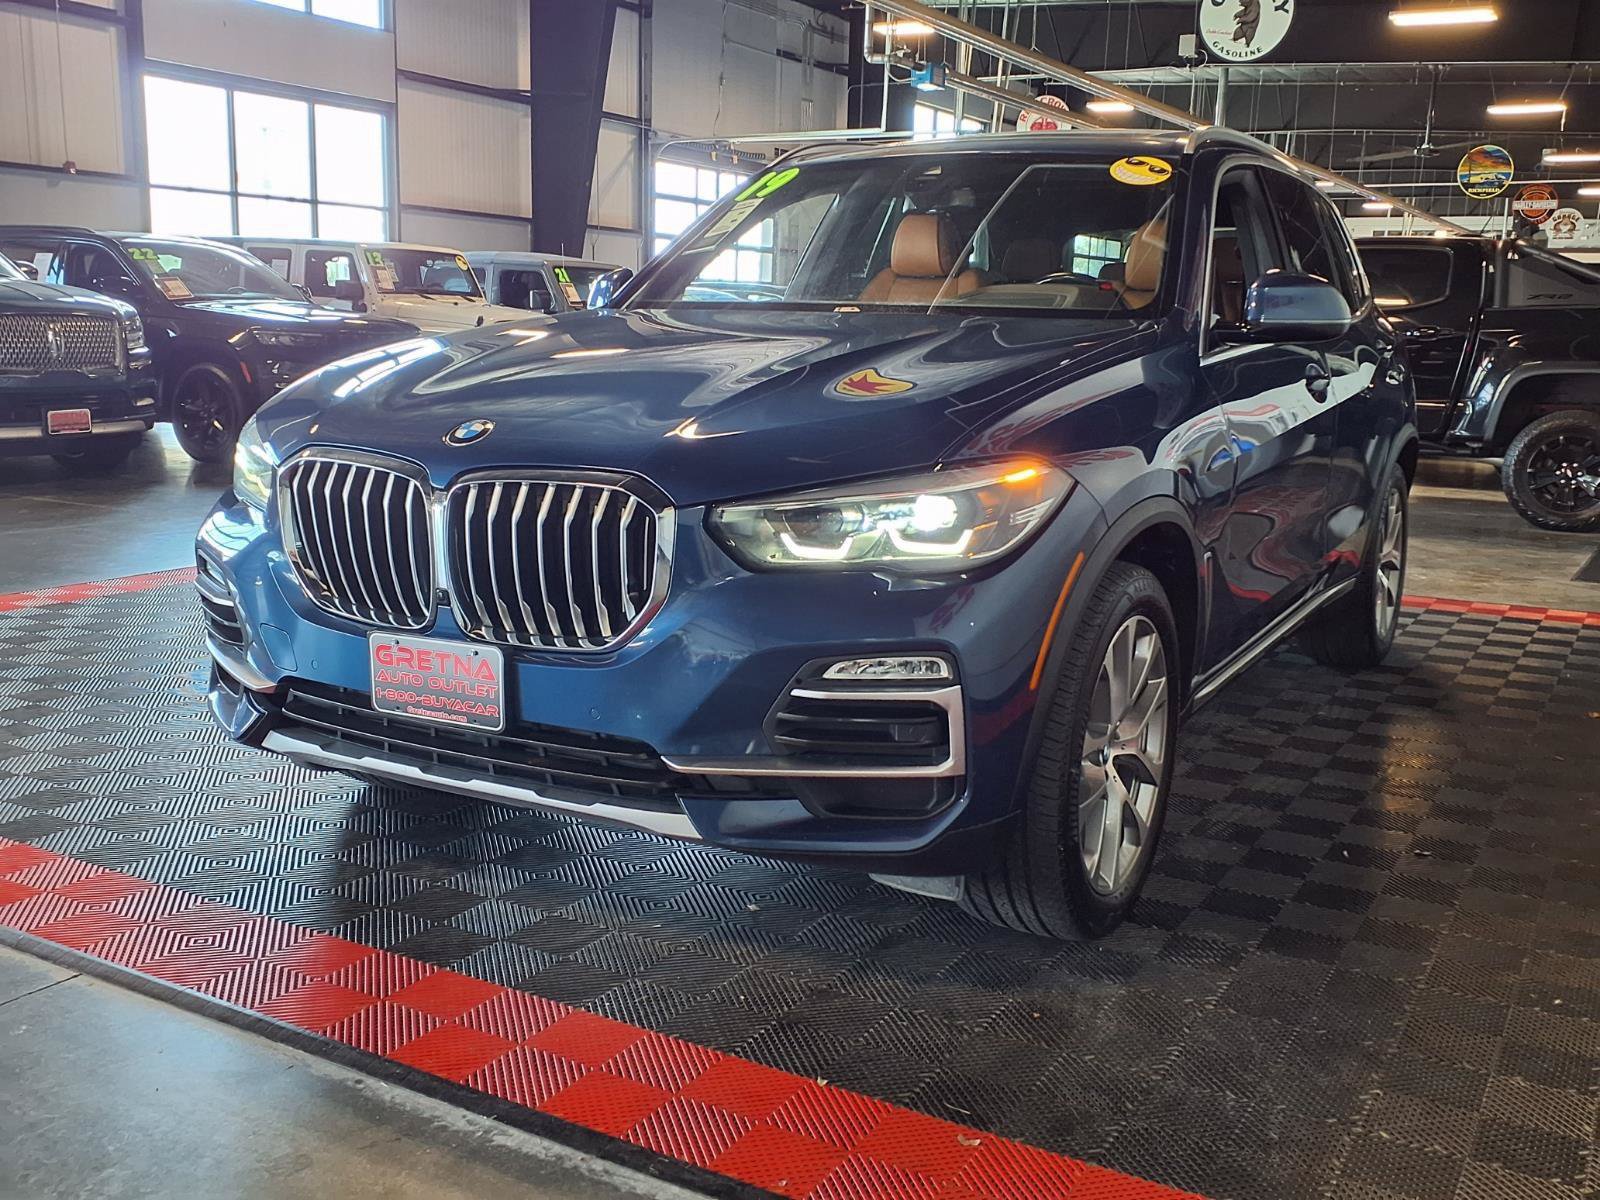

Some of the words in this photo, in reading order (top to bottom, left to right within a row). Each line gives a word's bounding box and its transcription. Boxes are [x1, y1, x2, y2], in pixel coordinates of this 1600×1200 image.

[1212, 40, 1264, 58] GASOLINE
[734, 167, 800, 201] 19
[128, 247, 159, 260] 22
[554, 268, 571, 282] 21
[375, 644, 497, 681] GRETNA
[376, 669, 424, 687] AUTO
[428, 676, 498, 698] OUTLET
[376, 687, 499, 717] 1-800-BUYACAR
